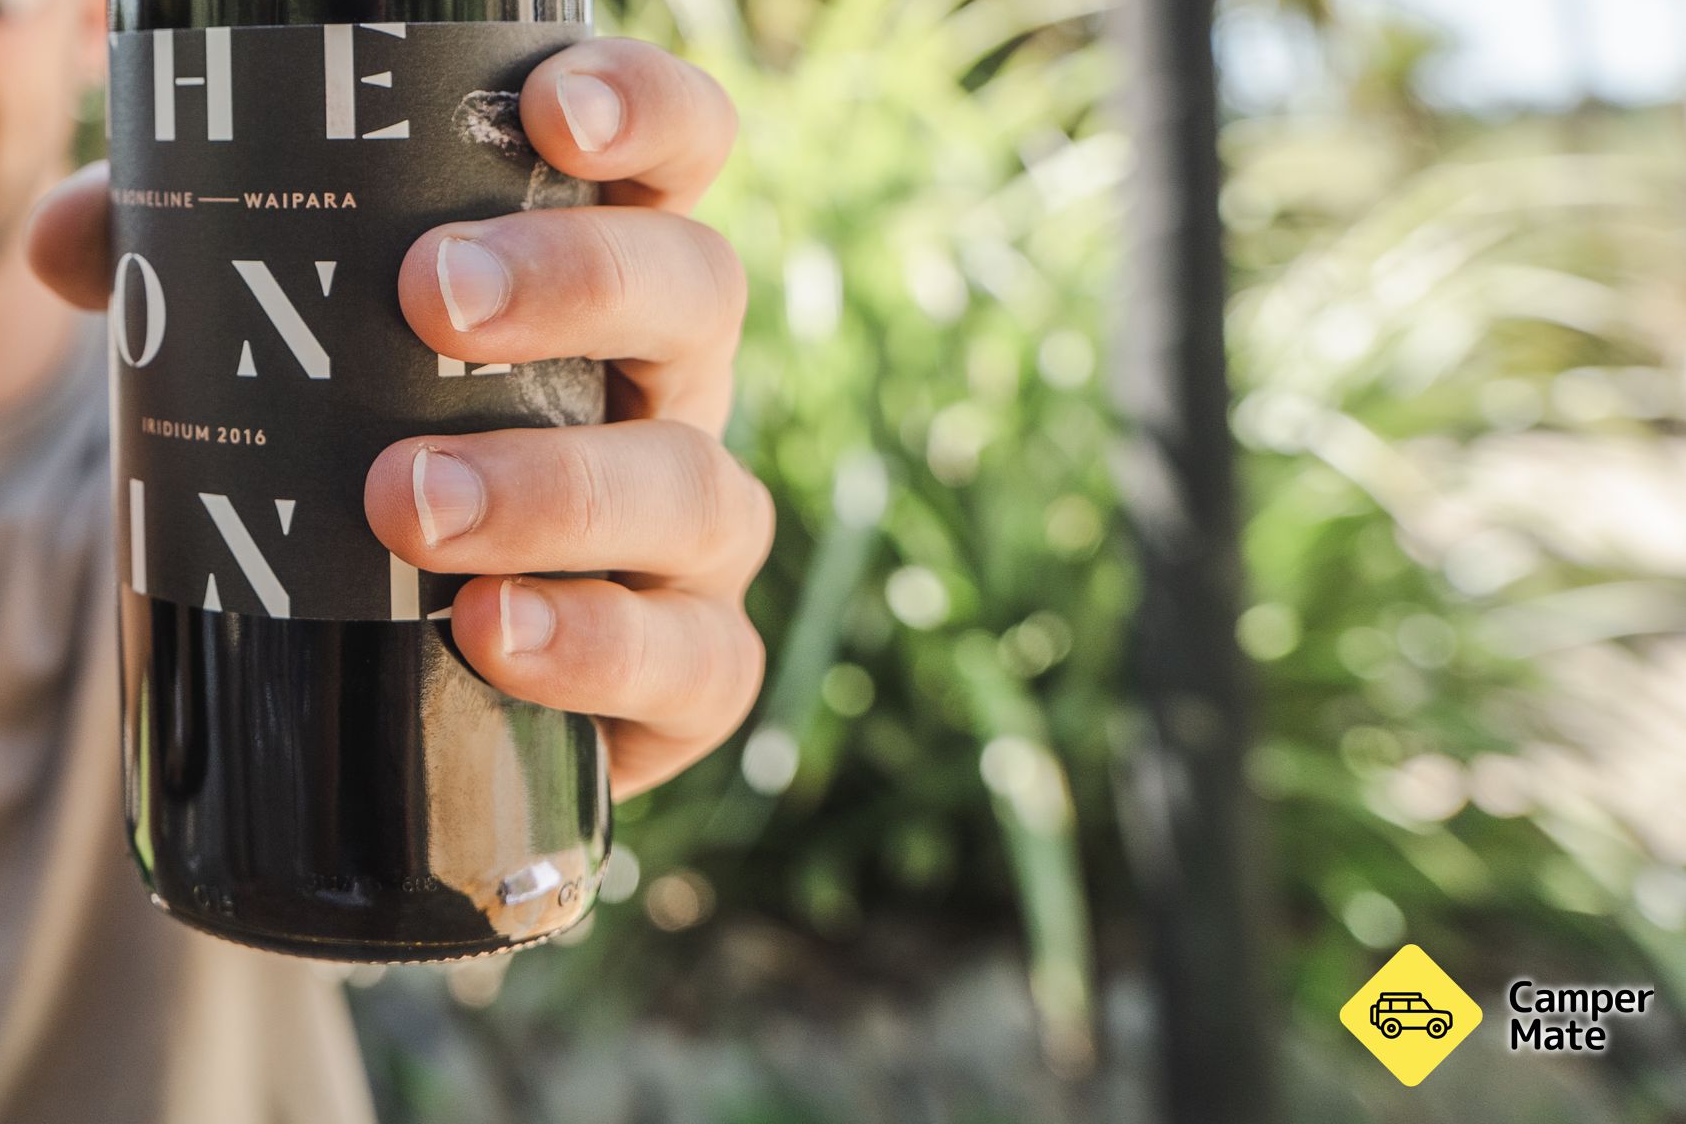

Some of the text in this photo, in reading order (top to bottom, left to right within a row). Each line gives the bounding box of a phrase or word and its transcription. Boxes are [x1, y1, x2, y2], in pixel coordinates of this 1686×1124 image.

[244, 191, 357, 209] WAIPARA
[110, 252, 512, 379] ON
[141, 416, 267, 447] IRIDIUM 2016
